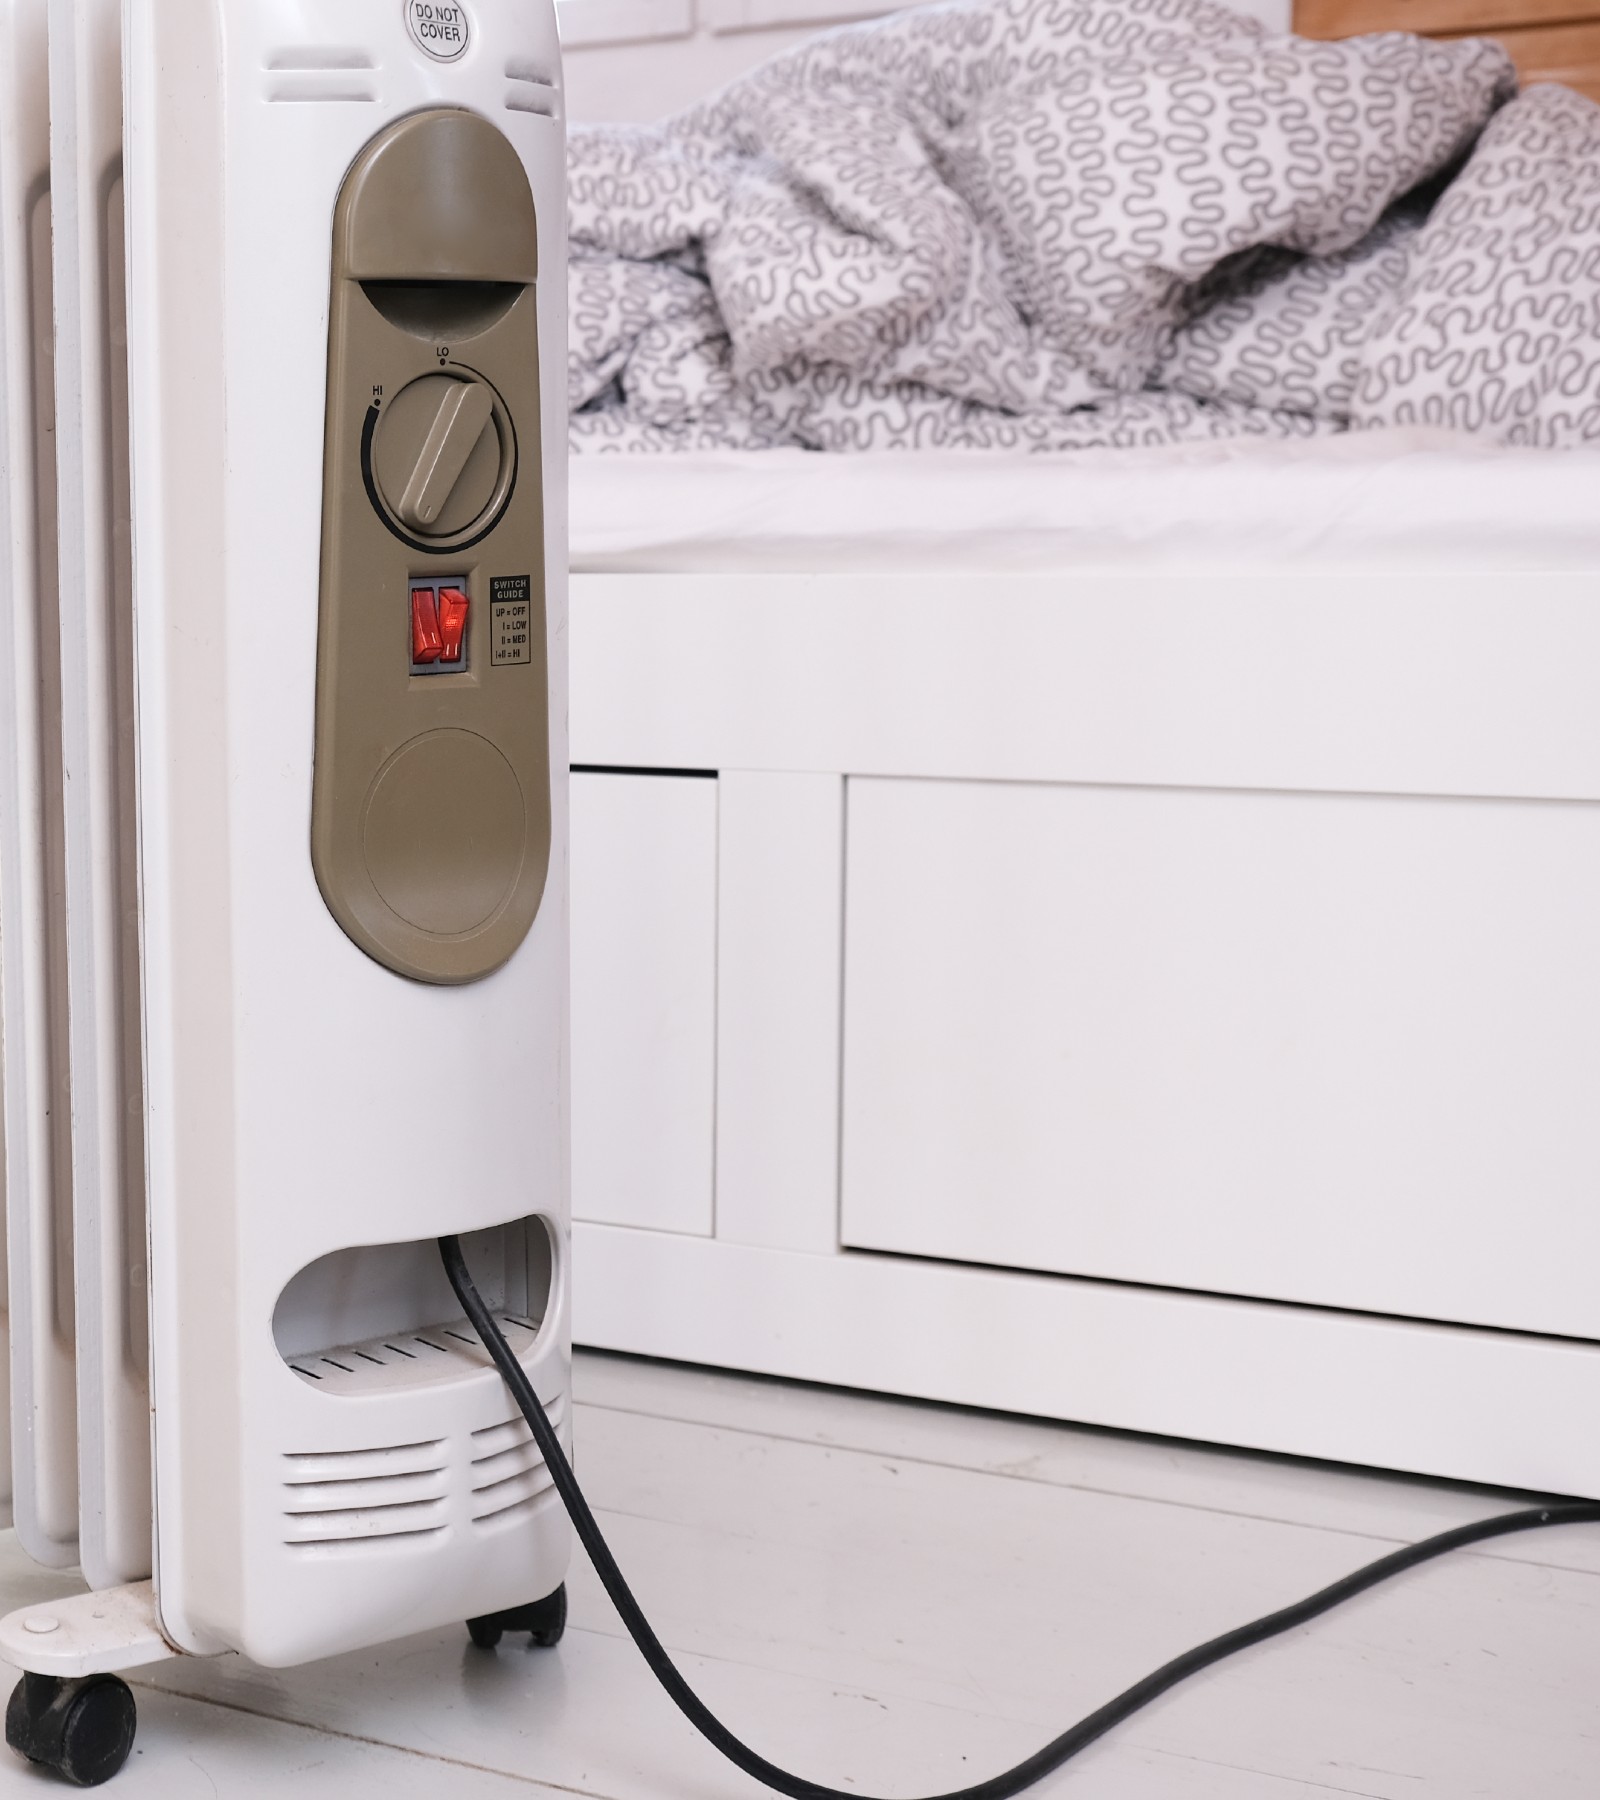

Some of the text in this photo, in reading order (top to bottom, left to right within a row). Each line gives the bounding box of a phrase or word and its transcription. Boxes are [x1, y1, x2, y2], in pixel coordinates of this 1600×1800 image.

[416, 4, 458, 23] DO NOT
[420, 23, 460, 42] COVER
[436, 347, 449, 357] LO
[372, 385, 383, 396] HI
[494, 580, 526, 590] SWITCH
[497, 590, 524, 599] GUIDE
[495, 608, 505, 617] UP
[512, 606, 526, 616] OFF
[512, 620, 527, 630] LOW
[512, 634, 527, 644] MED
[513, 649, 520, 658] HI
